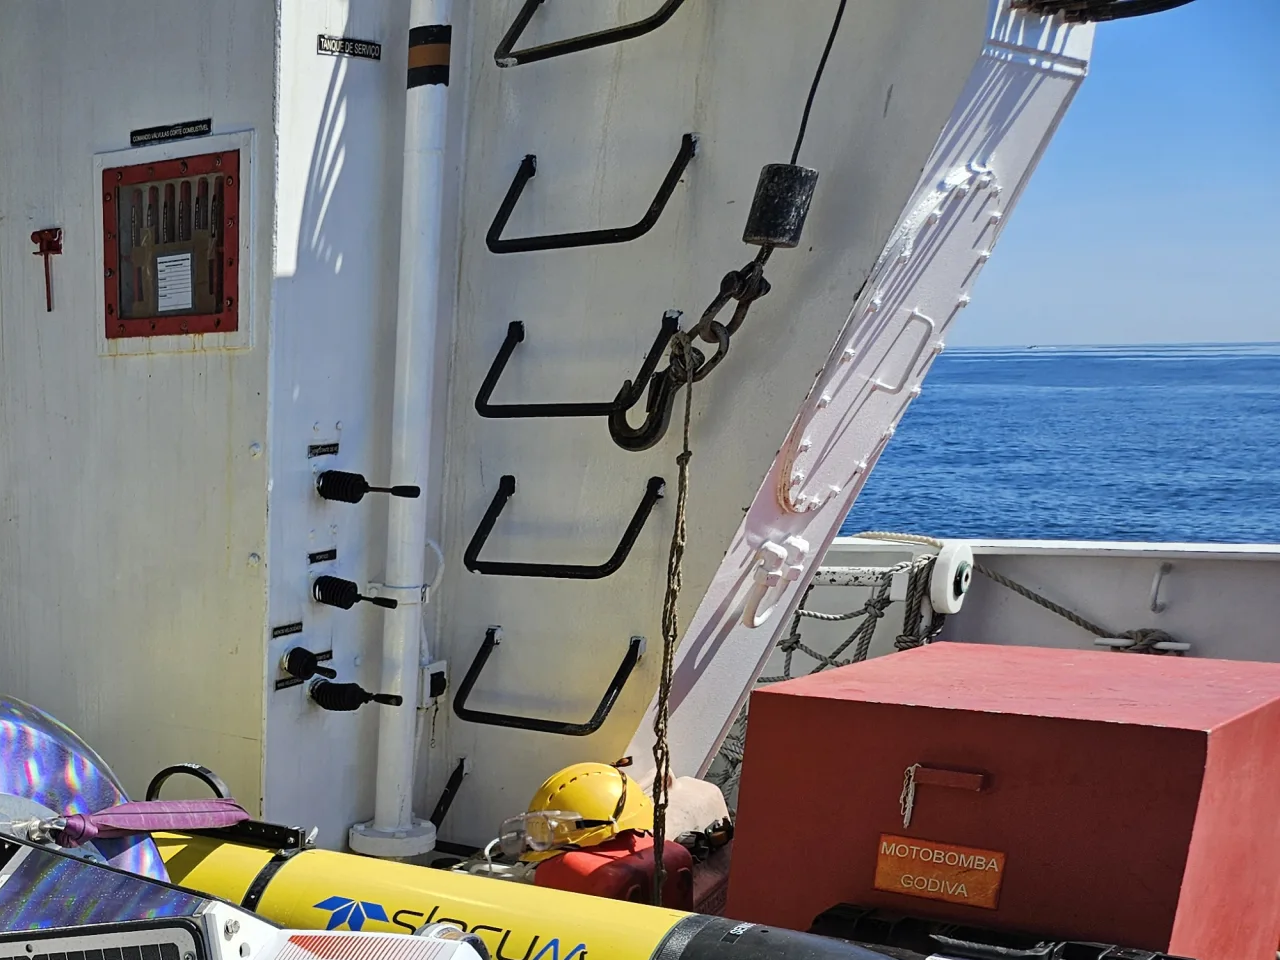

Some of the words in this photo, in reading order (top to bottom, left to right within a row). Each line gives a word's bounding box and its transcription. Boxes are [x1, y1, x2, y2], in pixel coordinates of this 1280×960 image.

[320, 38, 344, 52] TANQUE
[345, 41, 354, 54] DE
[354, 43, 380, 58] SERVIÇO
[881, 841, 999, 872] MOTOBOMBA
[900, 874, 968, 897] GODIVA
